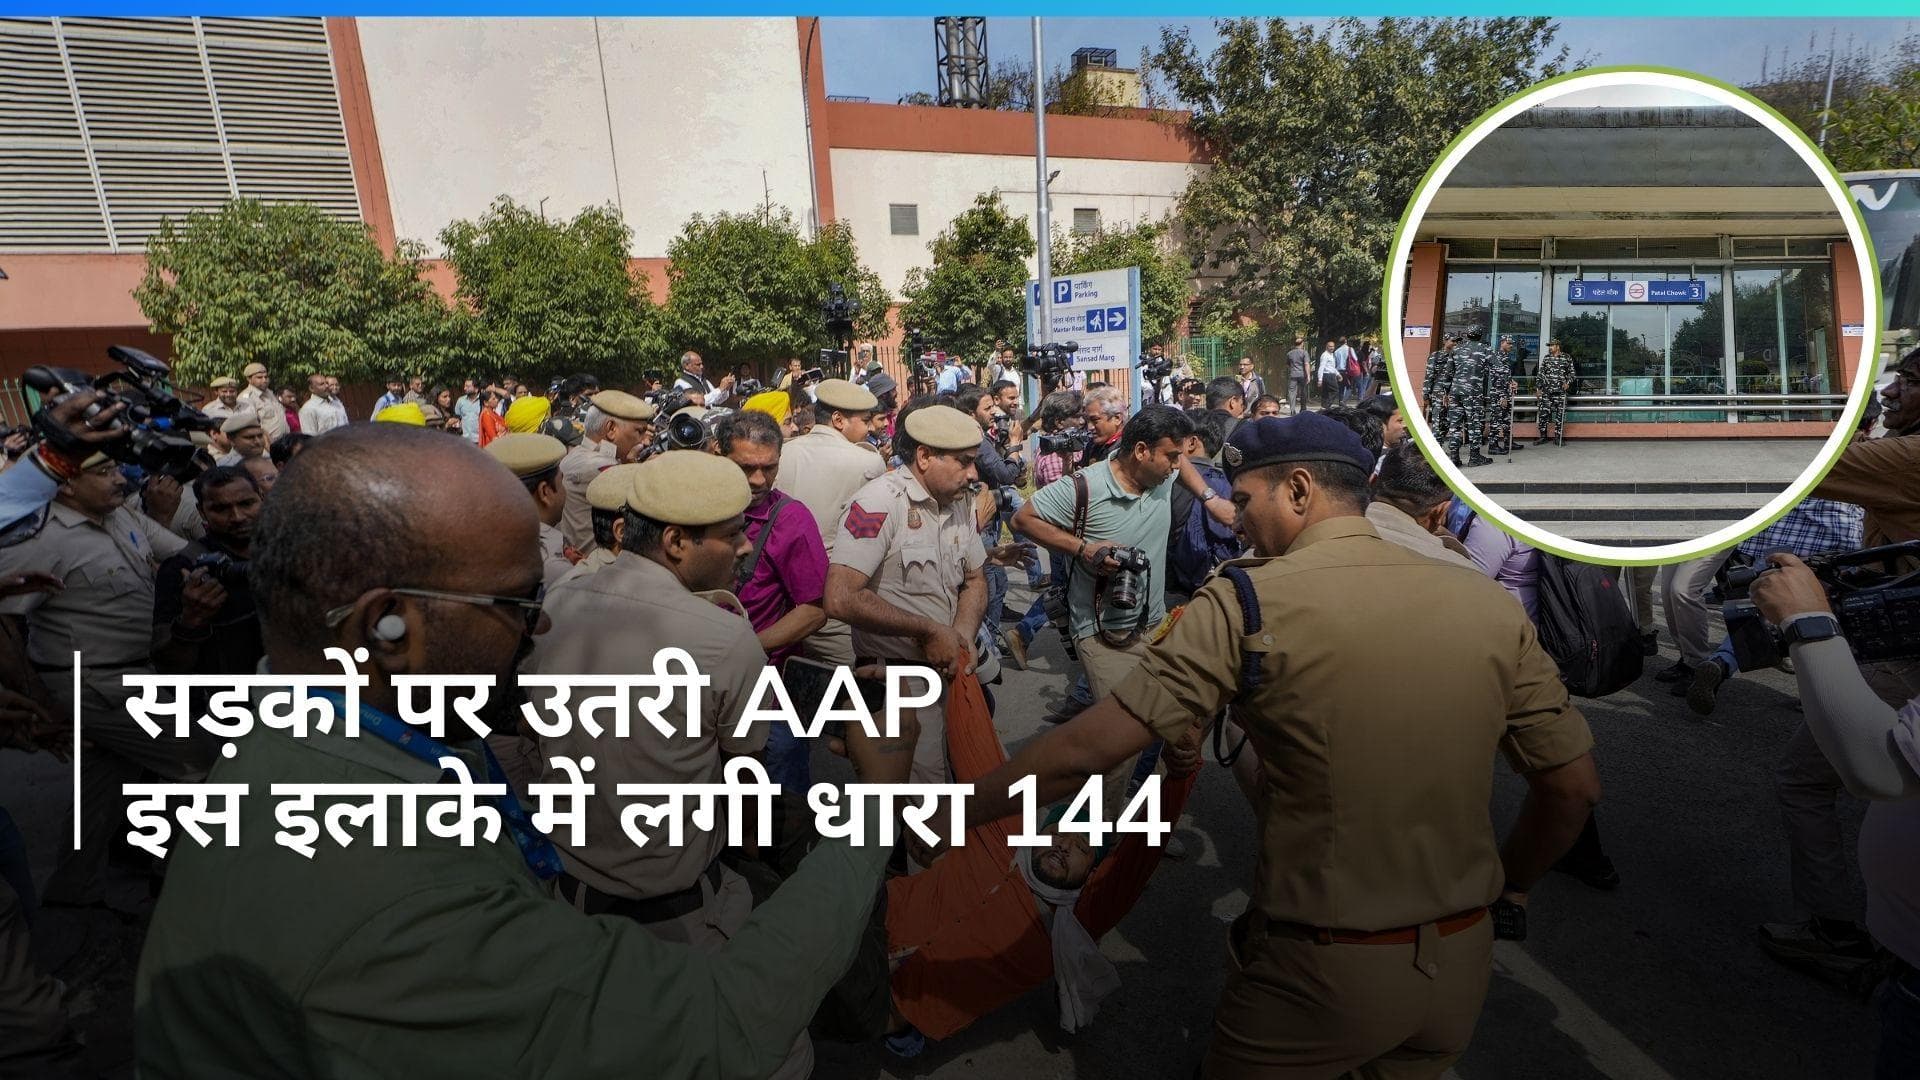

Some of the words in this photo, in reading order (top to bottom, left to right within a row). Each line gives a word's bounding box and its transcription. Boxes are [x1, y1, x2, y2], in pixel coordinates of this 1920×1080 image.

[1574, 287, 1582, 298] 3
[1692, 287, 1699, 298] 3
[1076, 354, 1098, 362] Sansad
[1099, 354, 1115, 362] Marg
